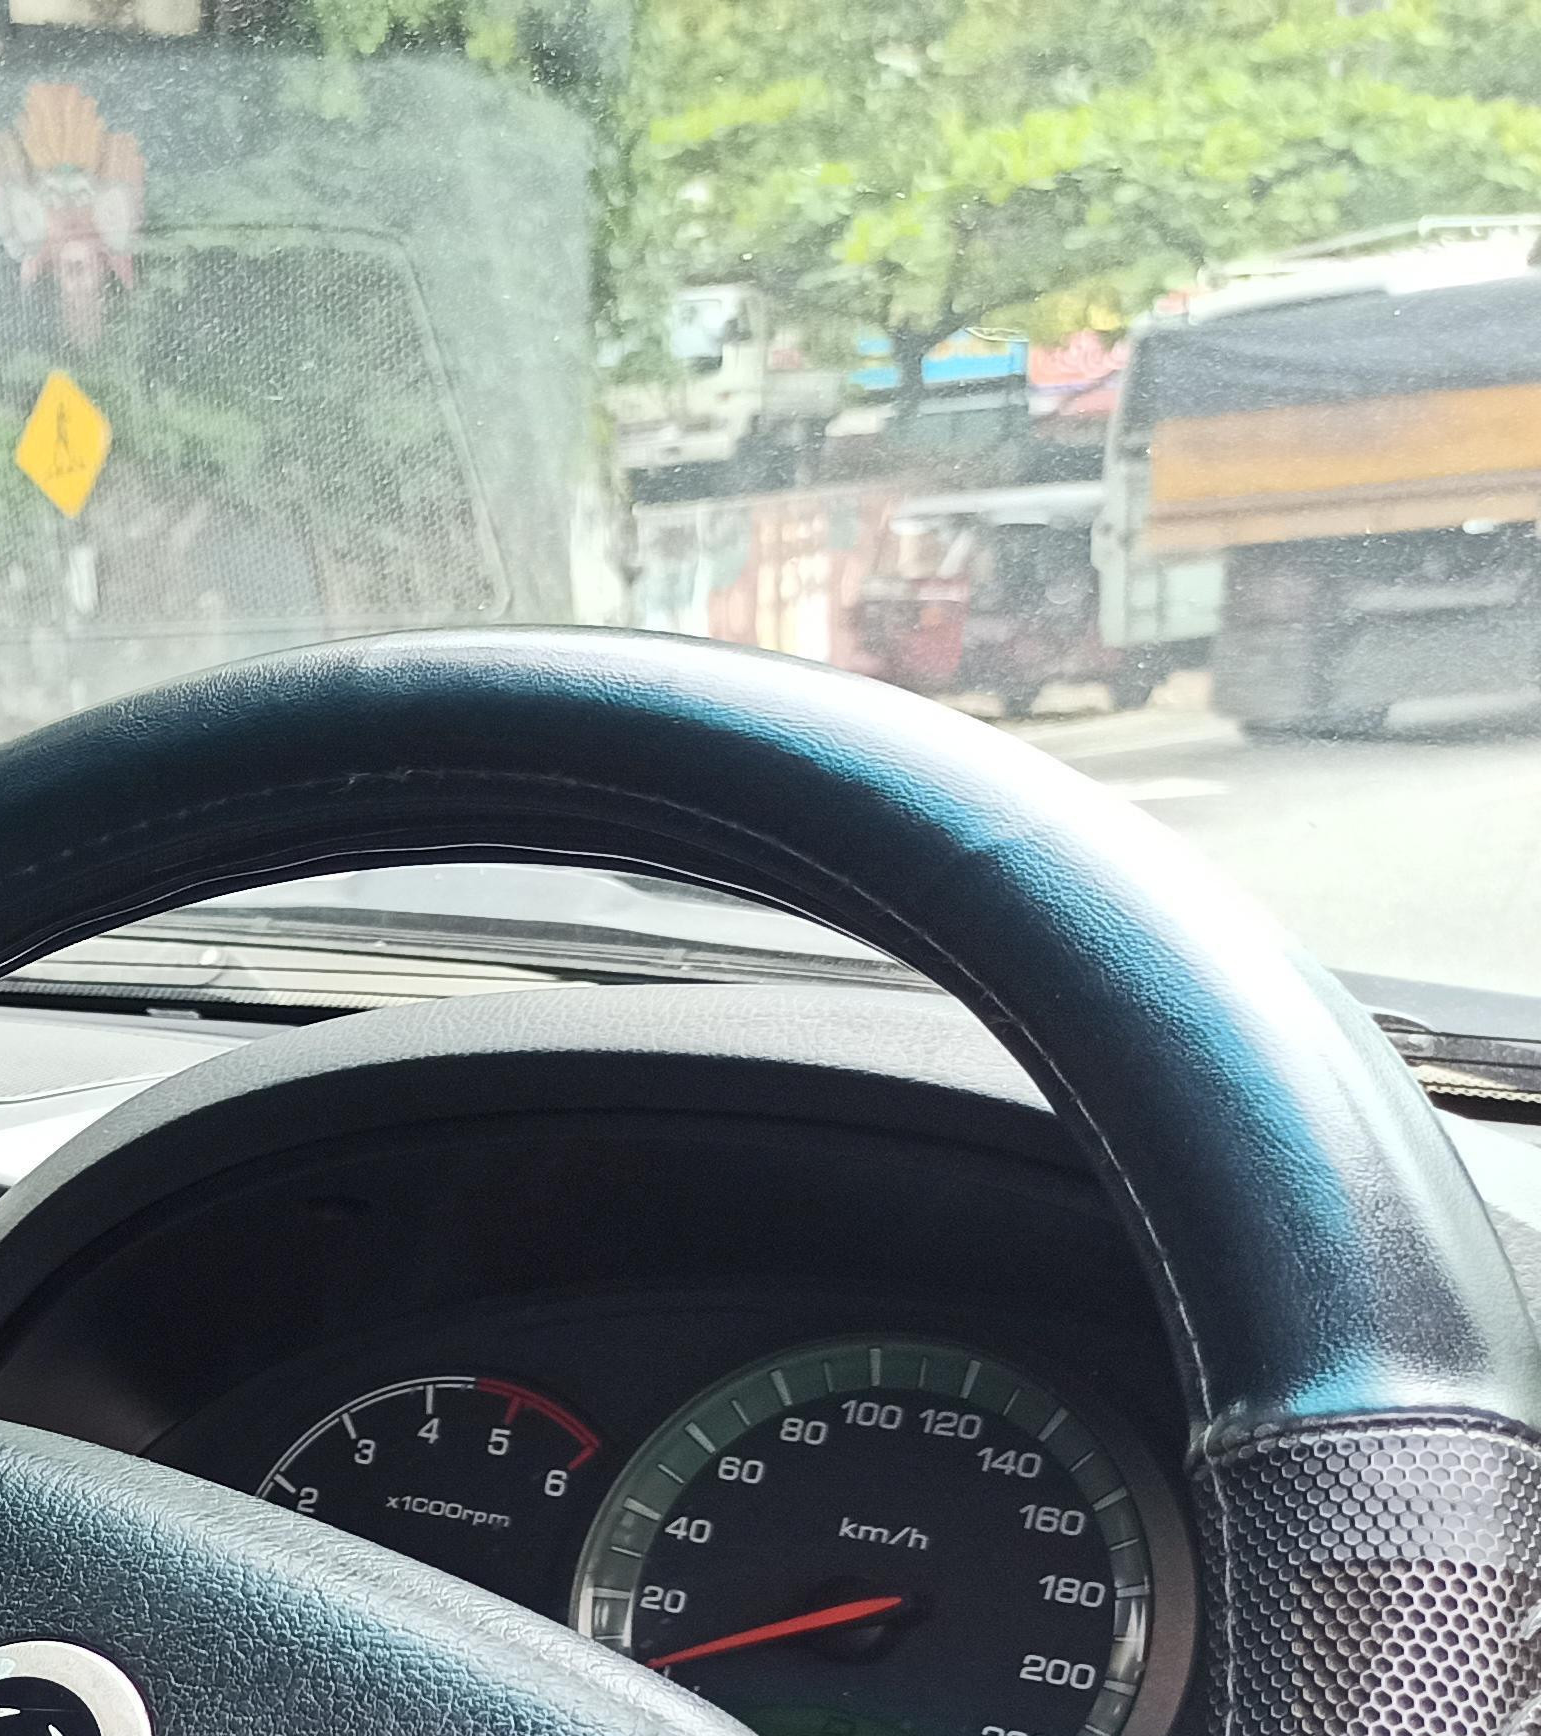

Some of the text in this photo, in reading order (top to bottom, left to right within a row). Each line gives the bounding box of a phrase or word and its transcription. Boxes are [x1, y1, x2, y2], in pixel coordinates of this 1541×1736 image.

[840, 1399, 904, 1431] 100
[918, 1408, 983, 1440] 120
[417, 1417, 440, 1444] 4
[486, 1428, 512, 1456] 5
[779, 1417, 829, 1446] 80
[353, 1438, 377, 1465] 3
[976, 1446, 1044, 1479] 140
[543, 1469, 568, 1498] 6
[717, 1456, 765, 1485] 60
[296, 1487, 319, 1513] 2
[664, 1516, 713, 1544] 40
[837, 1517, 930, 1550] km/h
[1018, 1503, 1086, 1537] 160
[639, 1585, 688, 1614] 20
[1038, 1574, 1107, 1609] 180
[1018, 1653, 1097, 1691] 200
